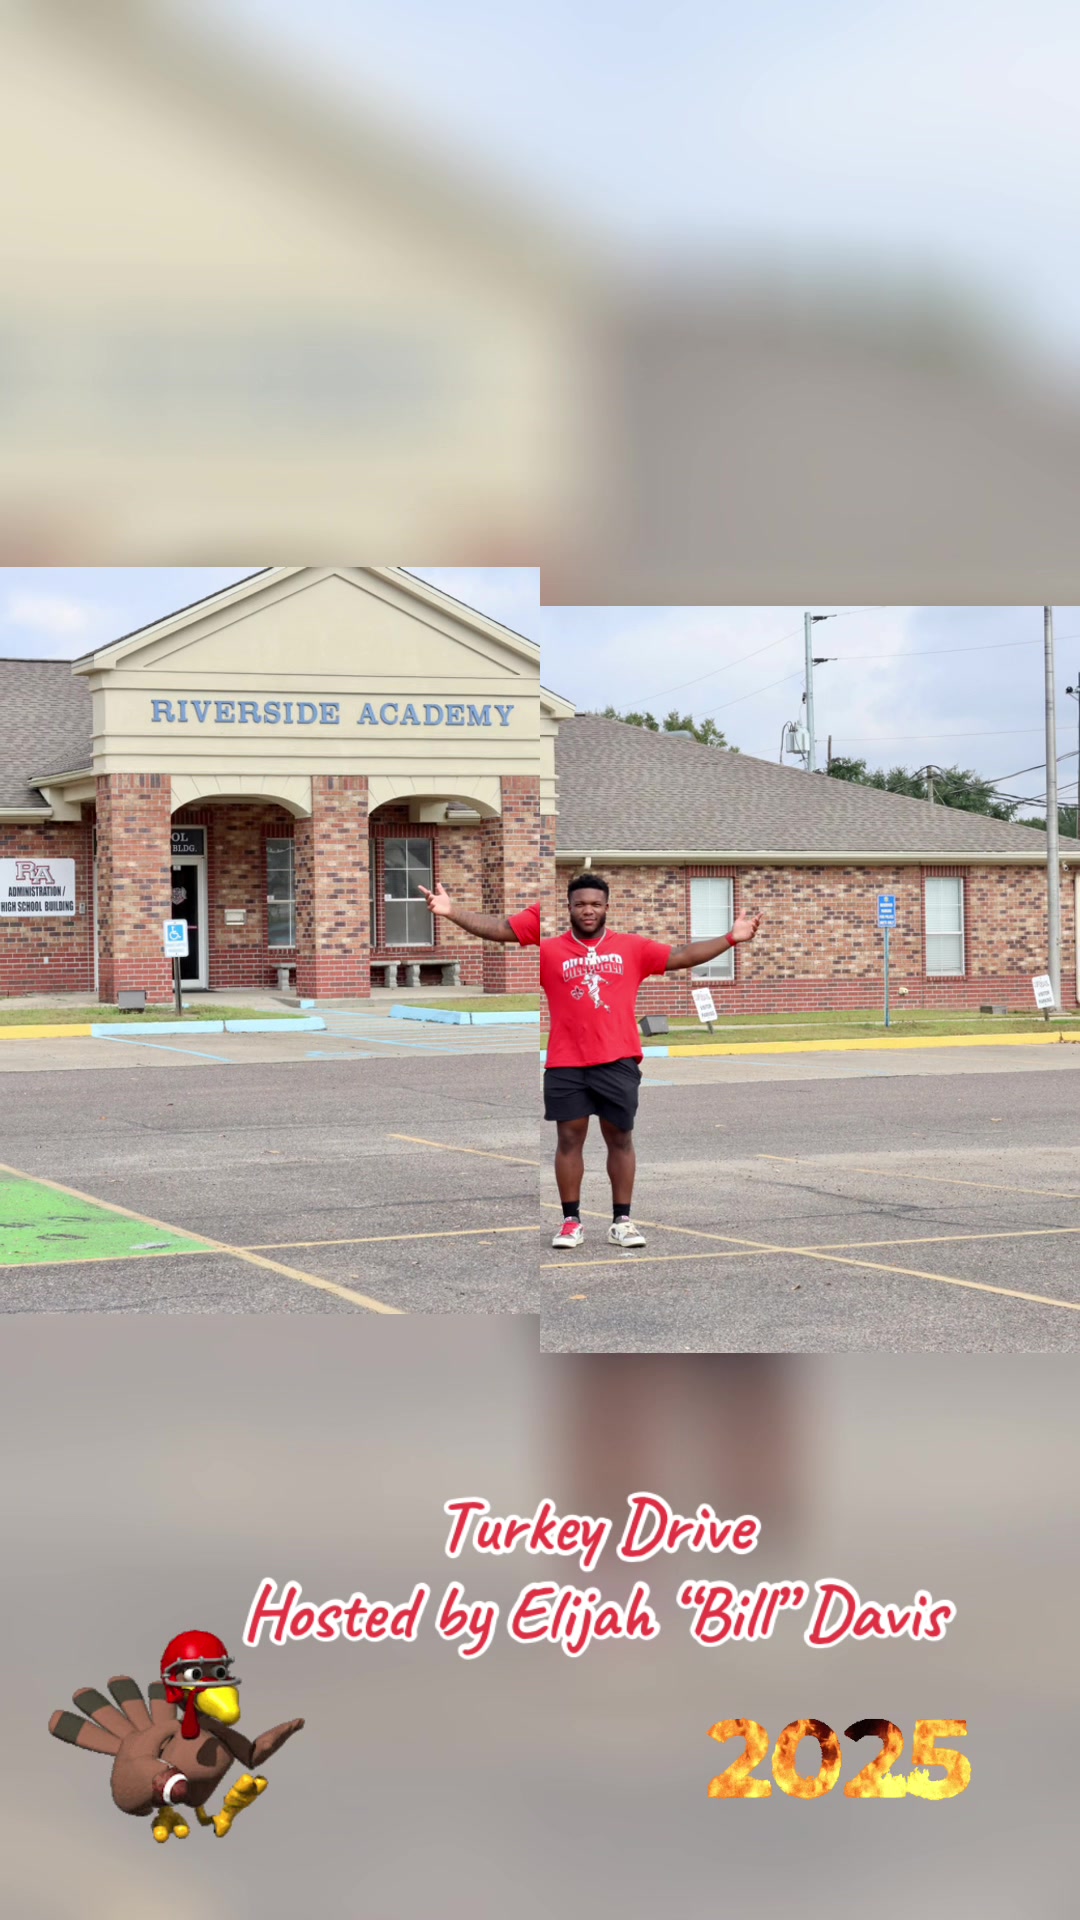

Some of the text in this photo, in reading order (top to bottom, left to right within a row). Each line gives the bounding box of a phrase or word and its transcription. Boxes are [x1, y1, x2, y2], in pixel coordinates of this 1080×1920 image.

[151, 699, 515, 726] RIVERSIDE ACADEMY
[15, 860, 56, 885] RA
[8, 886, 61, 897] ADMINISTRATION
[0, 900, 74, 912] HIGH SCHOOL BUILDING
